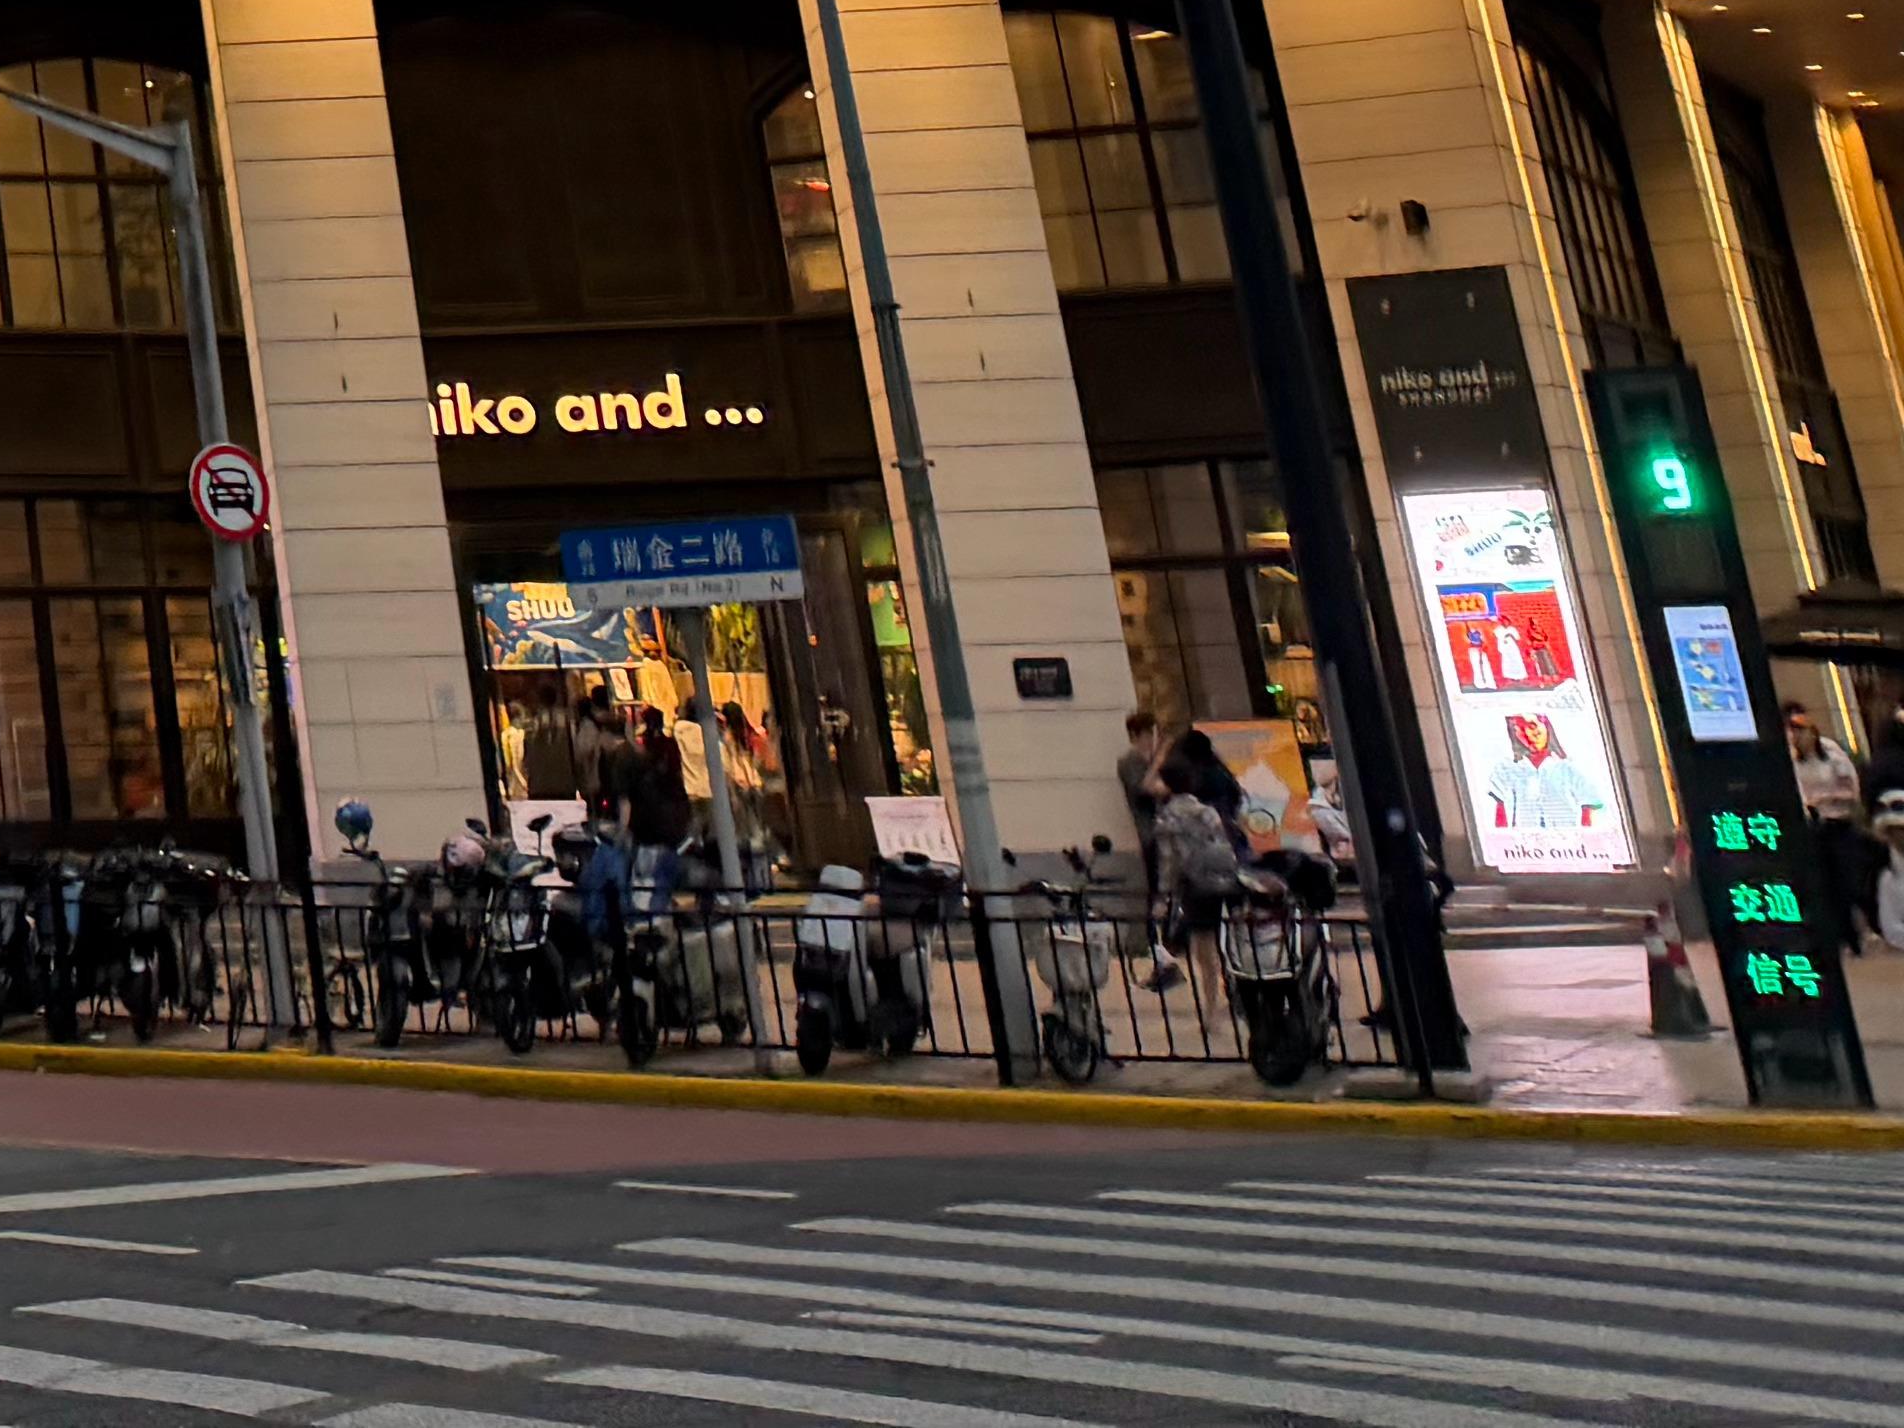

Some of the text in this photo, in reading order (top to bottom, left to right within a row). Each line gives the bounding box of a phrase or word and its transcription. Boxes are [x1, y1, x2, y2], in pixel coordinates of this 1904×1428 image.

[555, 373, 687, 433] and
[1653, 457, 1692, 509] 9
[770, 576, 784, 592] N
[1712, 811, 1782, 851] 遵守
[1503, 845, 1545, 861] niko
[1549, 844, 1588, 860] and
[1730, 883, 1803, 925] 交通
[1747, 952, 1822, 998] 信号
